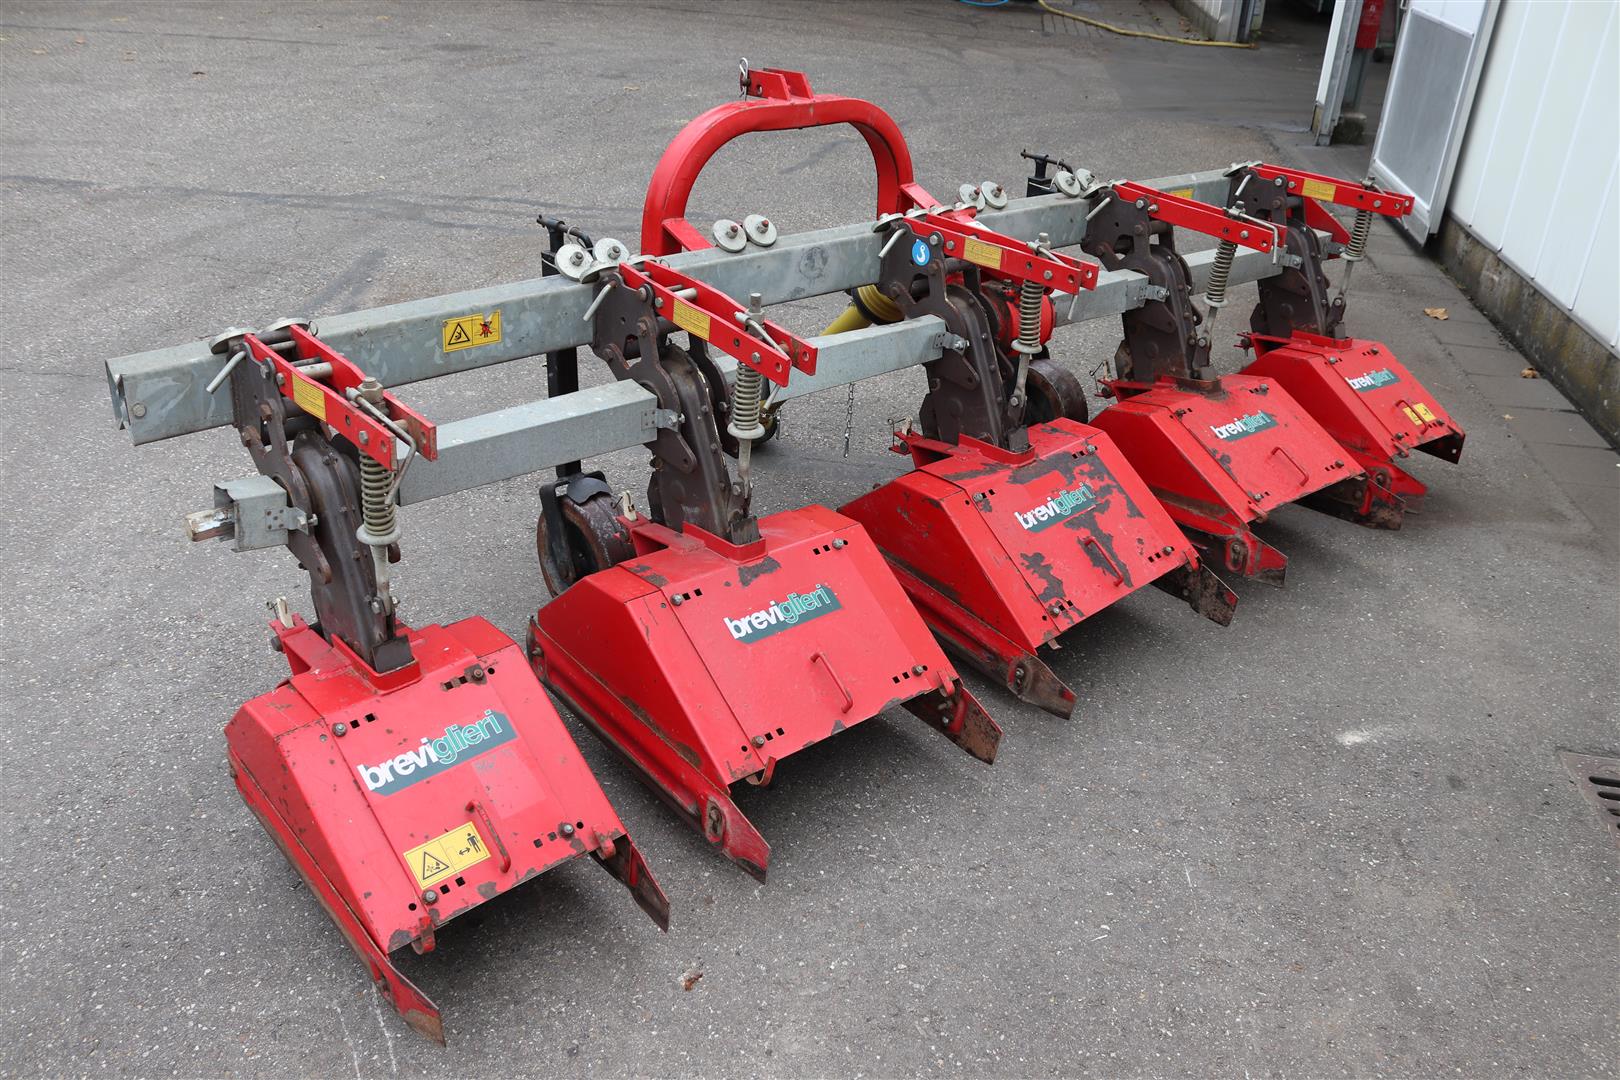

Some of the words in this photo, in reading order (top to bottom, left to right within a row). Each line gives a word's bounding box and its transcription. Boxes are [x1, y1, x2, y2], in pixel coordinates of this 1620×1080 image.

[1210, 411, 1272, 439] breviglieri
[1014, 482, 1094, 531] breviglieri
[723, 584, 830, 640] breviglieri
[357, 709, 502, 792] breviglieri
